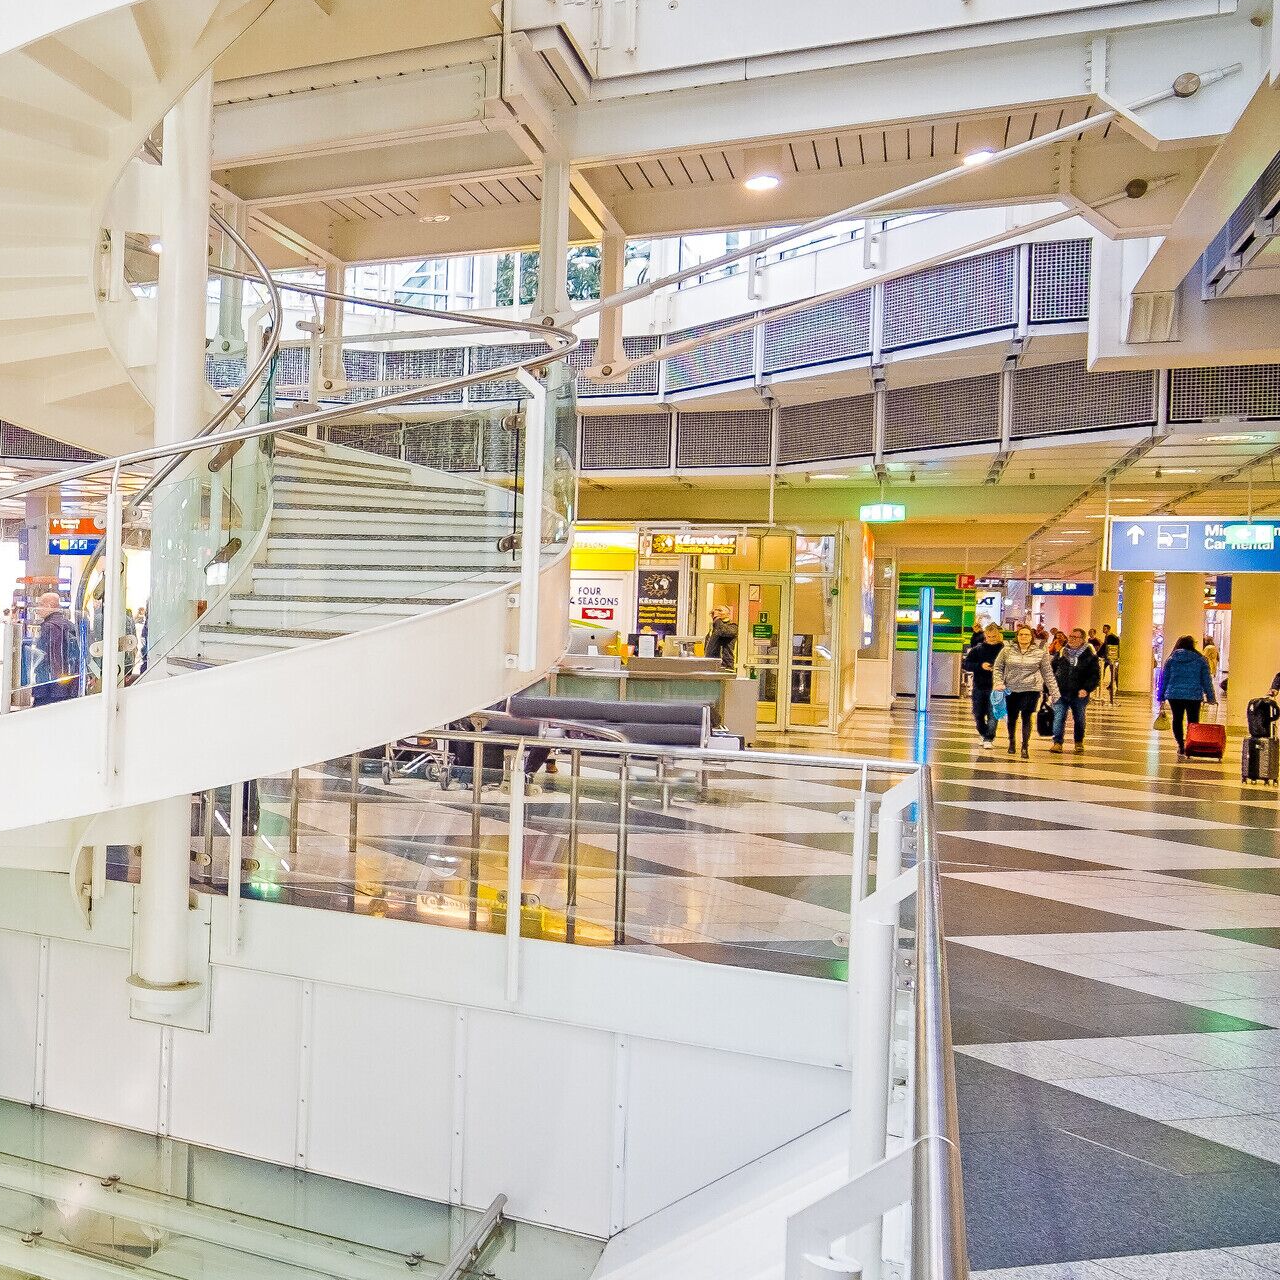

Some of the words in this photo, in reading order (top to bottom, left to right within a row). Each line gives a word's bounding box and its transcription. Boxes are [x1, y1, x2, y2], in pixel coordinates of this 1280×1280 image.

[1204, 537, 1226, 550] Car
[703, 544, 734, 553] Service
[578, 586, 602, 596] FOUR
[577, 597, 619, 606] SEASONS
